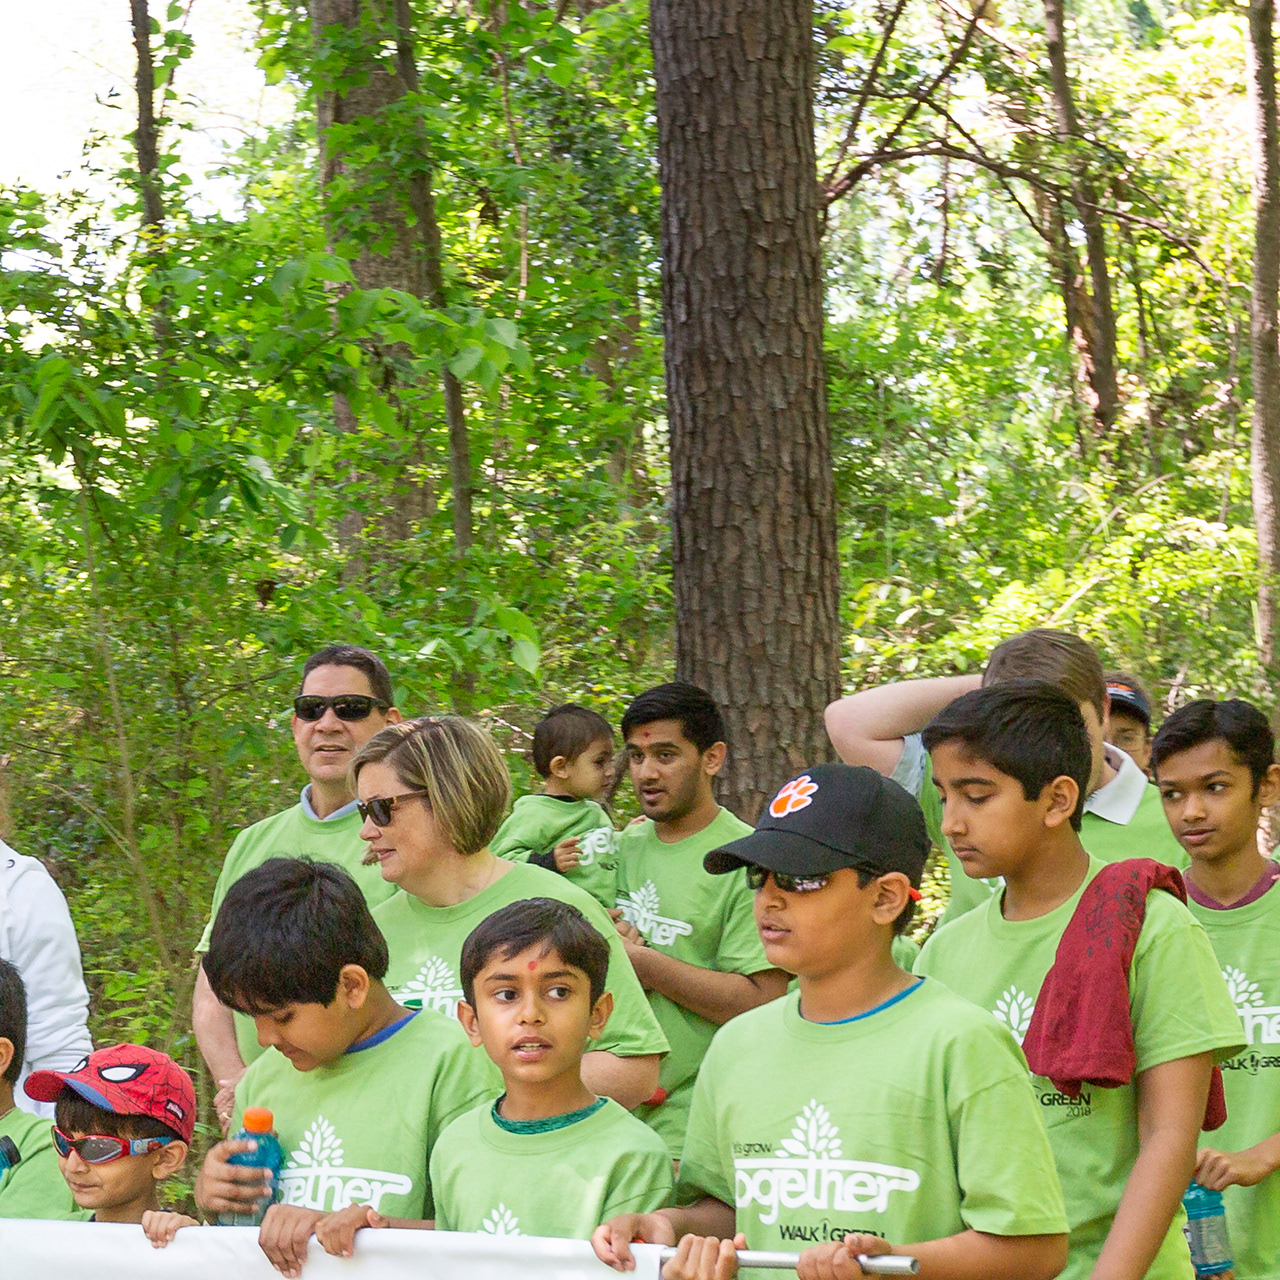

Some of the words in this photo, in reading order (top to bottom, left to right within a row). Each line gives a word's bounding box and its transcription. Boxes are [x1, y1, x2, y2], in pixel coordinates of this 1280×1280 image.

[1066, 1106, 1091, 1120] 2018
[734, 1150, 920, 1225] ogether
[779, 1225, 819, 1242] WALK
